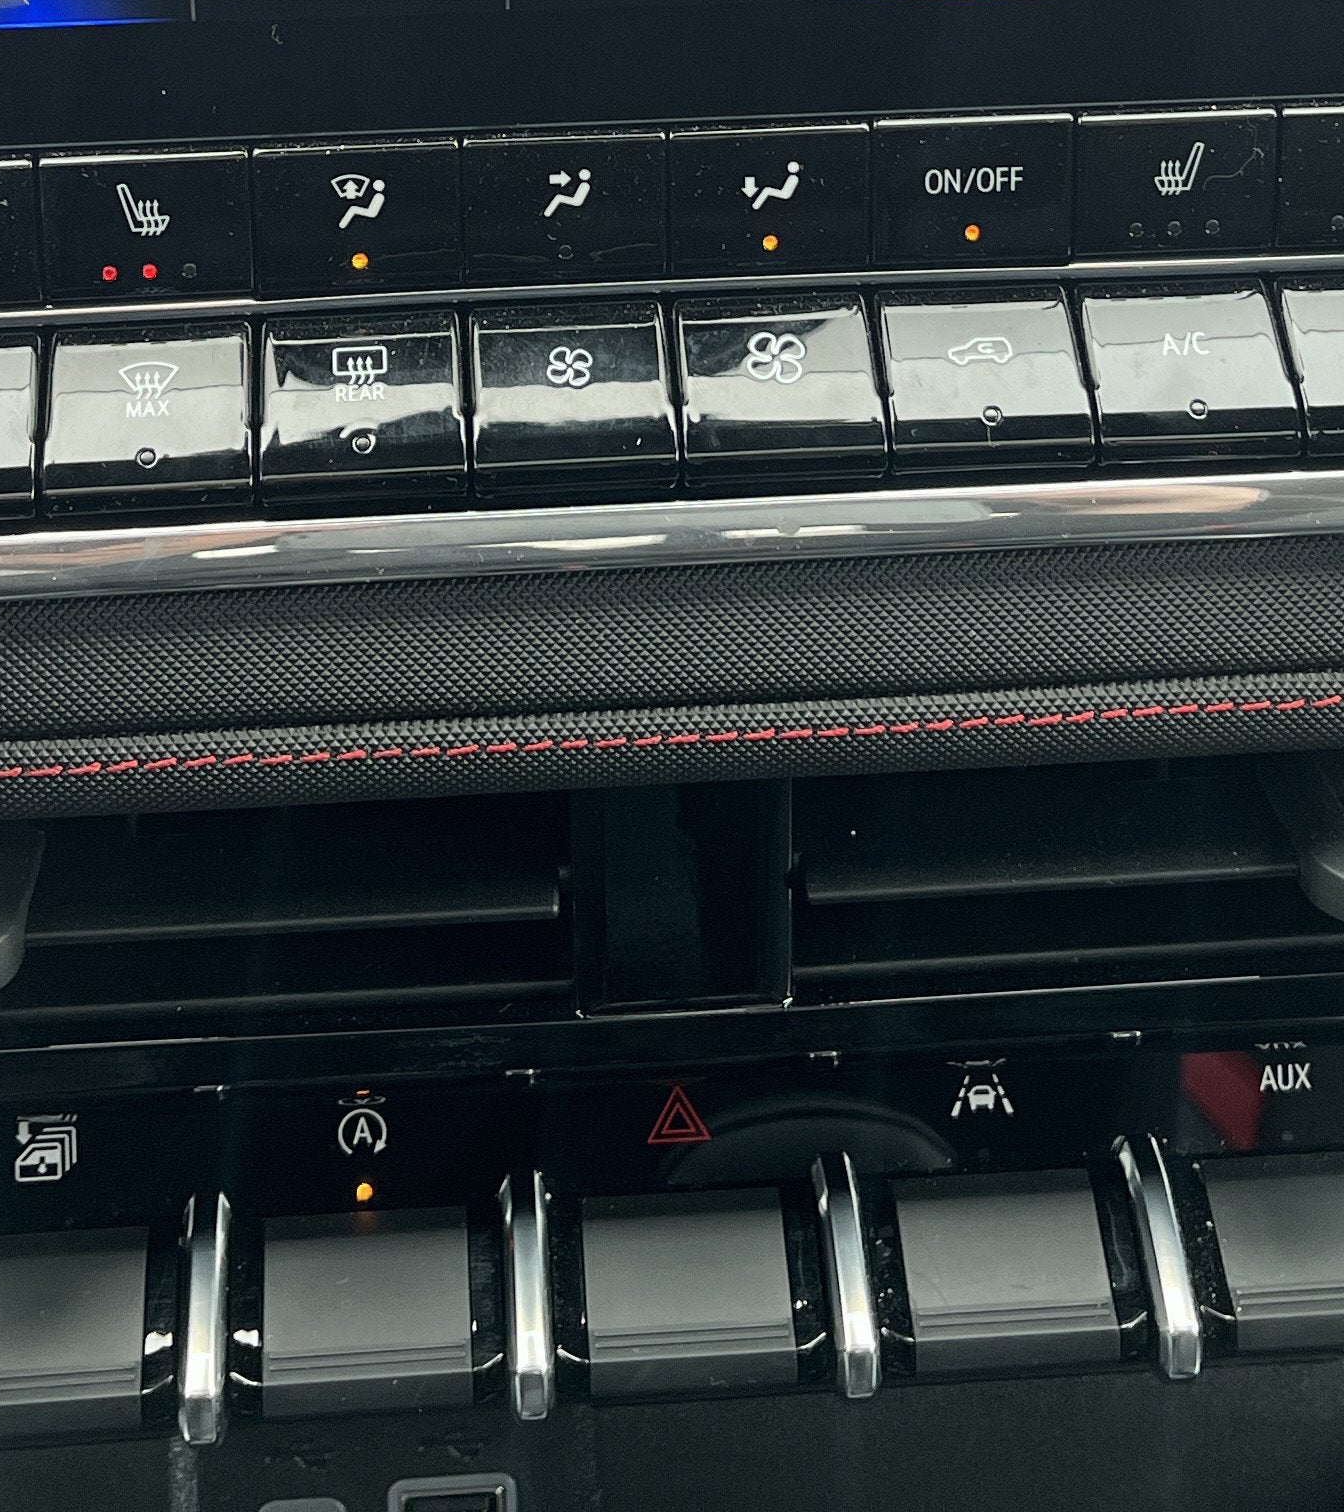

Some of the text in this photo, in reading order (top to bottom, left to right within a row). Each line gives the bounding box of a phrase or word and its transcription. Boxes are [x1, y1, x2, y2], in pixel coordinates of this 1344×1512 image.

[924, 166, 1024, 195] ON/OFF
[1162, 331, 1210, 356] A/C
[335, 383, 385, 402] REAR
[125, 399, 170, 418] MAX
[1259, 1062, 1313, 1092] AUX
[352, 1116, 373, 1146] A
